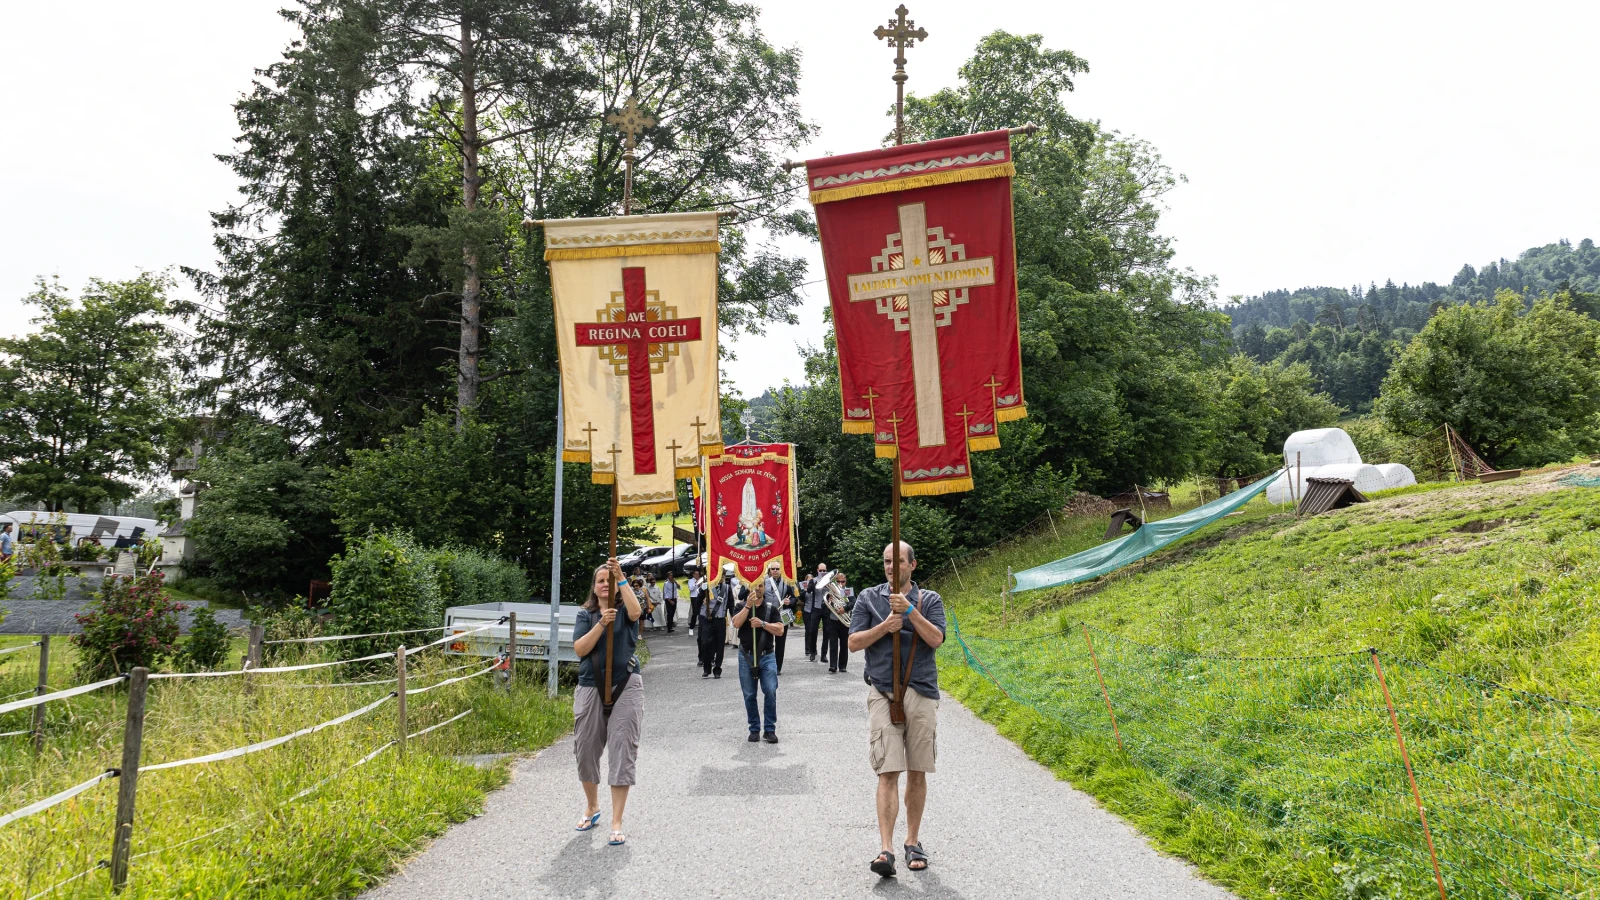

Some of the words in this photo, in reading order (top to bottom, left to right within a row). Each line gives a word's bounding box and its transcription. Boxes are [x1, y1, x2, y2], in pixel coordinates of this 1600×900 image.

[853, 278, 897, 293] LAUDATE
[901, 271, 943, 286] NOMEN
[944, 265, 989, 281] DOMINI
[627, 311, 646, 322] AVE
[588, 327, 641, 340] REGINA
[648, 325, 687, 338] COELI
[719, 473, 733, 484] NOSSA
